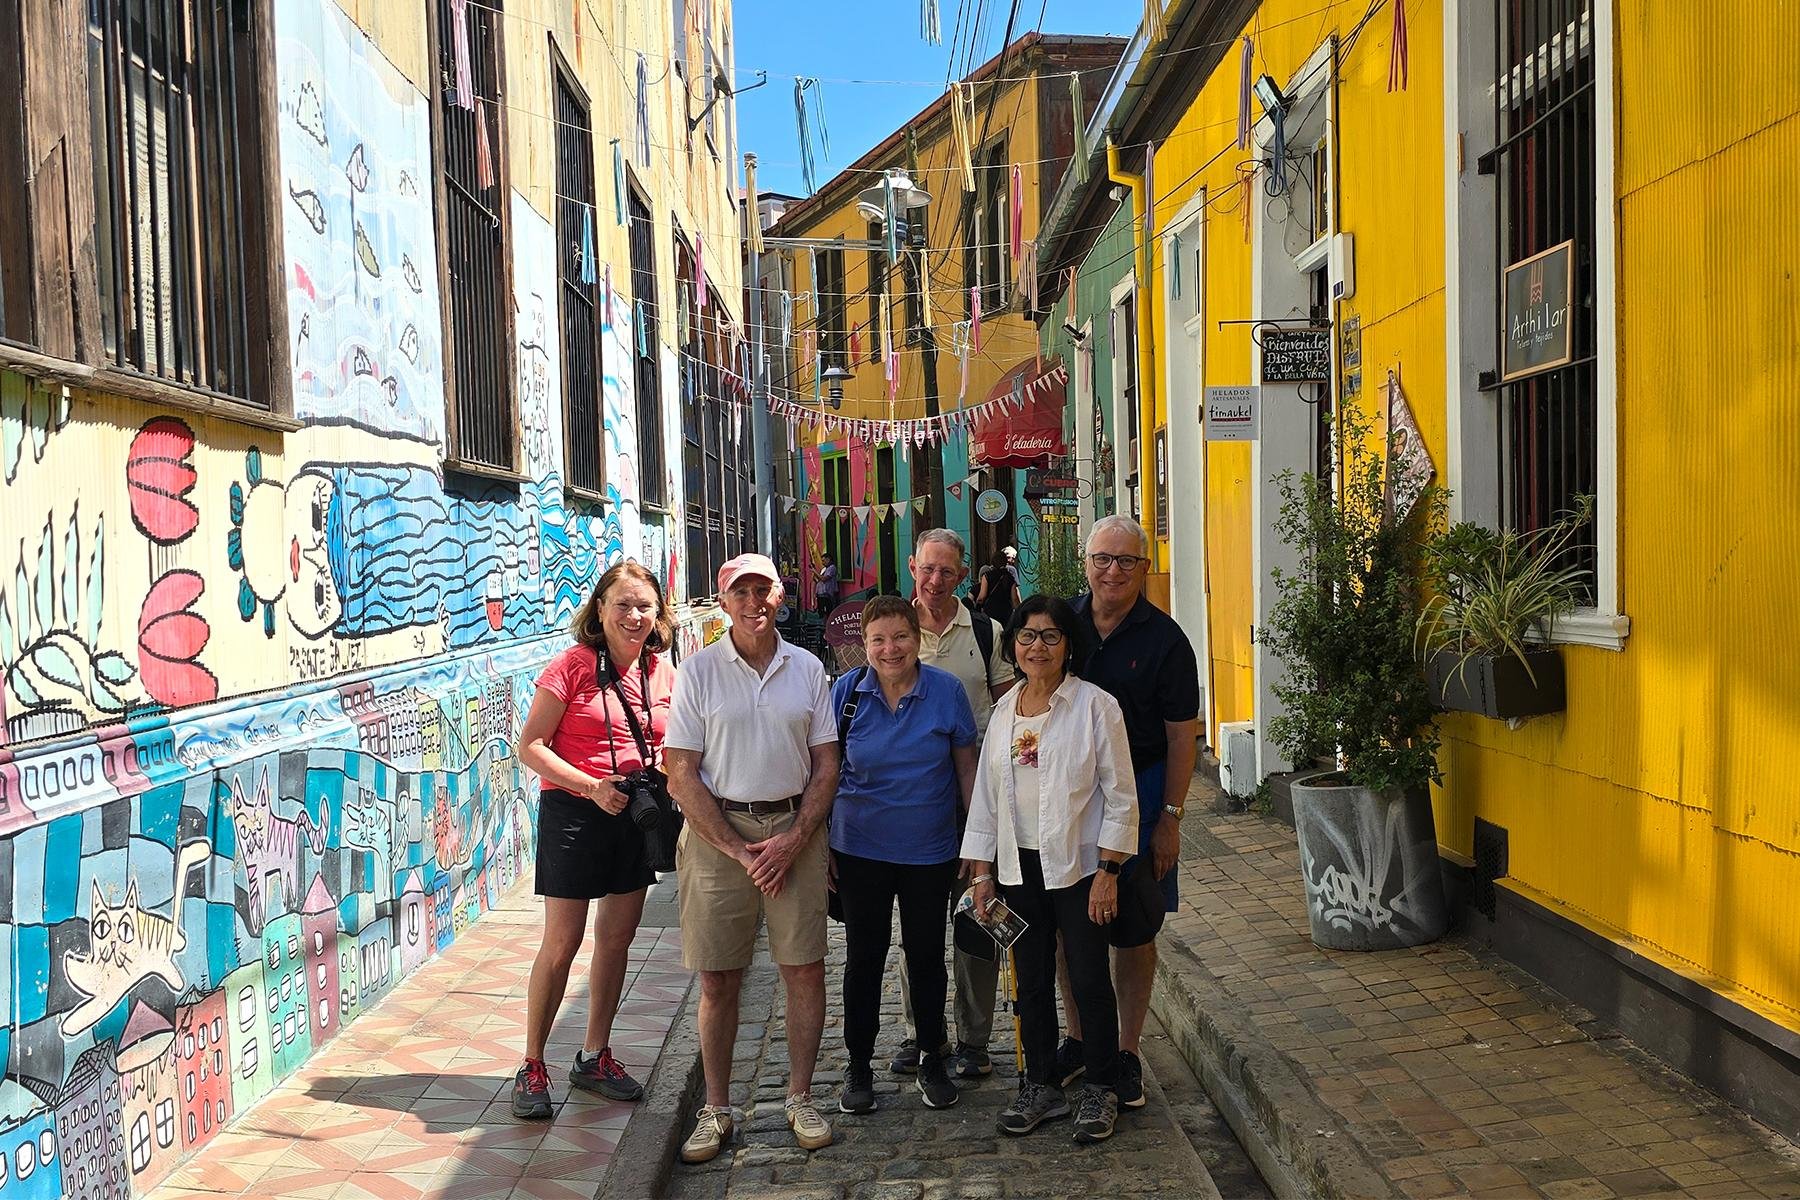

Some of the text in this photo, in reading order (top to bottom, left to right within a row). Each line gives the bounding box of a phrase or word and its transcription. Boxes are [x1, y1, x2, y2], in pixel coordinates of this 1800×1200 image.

[1265, 335, 1329, 351] Bienvenidos
[1264, 363, 1278, 374] de
[1280, 364, 1296, 373] un
[1042, 514, 1078, 524] FIETRO
